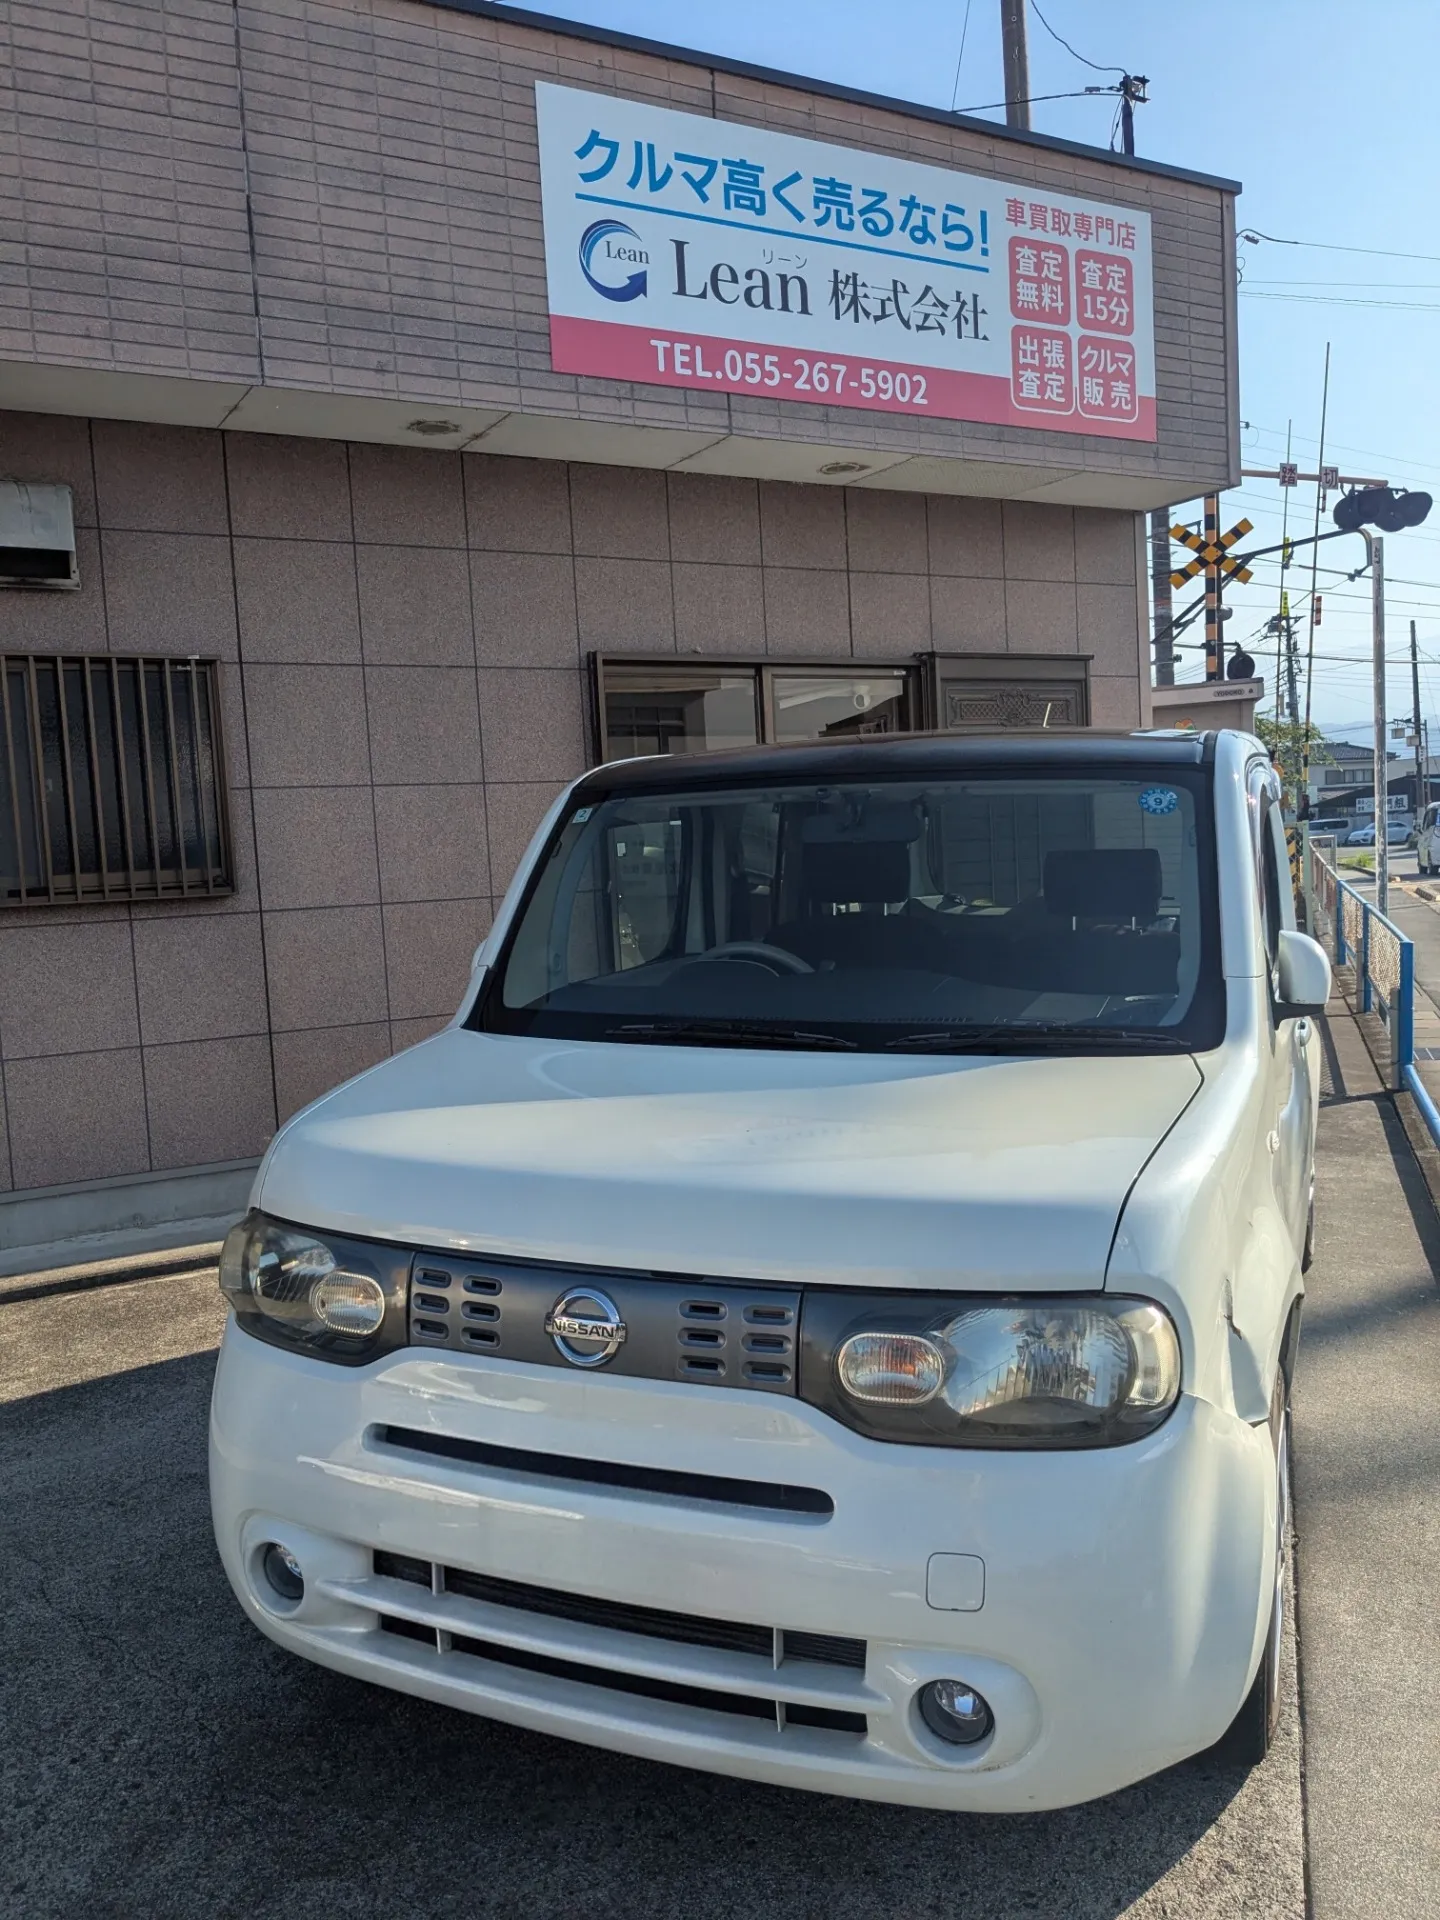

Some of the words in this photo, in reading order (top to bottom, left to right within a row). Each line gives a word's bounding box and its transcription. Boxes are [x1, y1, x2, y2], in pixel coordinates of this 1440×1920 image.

[574, 129, 989, 257] クルマ高く売るなら!
[1005, 198, 1136, 251] 車買取専門店
[605, 240, 650, 265] Lean
[762, 248, 808, 269] リーン
[1015, 245, 1063, 282] 査定
[669, 238, 813, 316] Lean
[828, 268, 990, 341] 株式会社
[1081, 259, 1127, 294] 査定
[1016, 279, 1064, 315] 無料
[1083, 294, 1130, 327] 15分
[1018, 335, 1065, 369] 出張
[1081, 345, 1133, 377] クルマ
[650, 339, 928, 405] TEL.055-267-5902
[1018, 368, 1066, 403] 査定
[1083, 376, 1132, 410] 販売
[1153, 797, 1163, 806] 9
[551, 1320, 615, 1338] NISSAN
